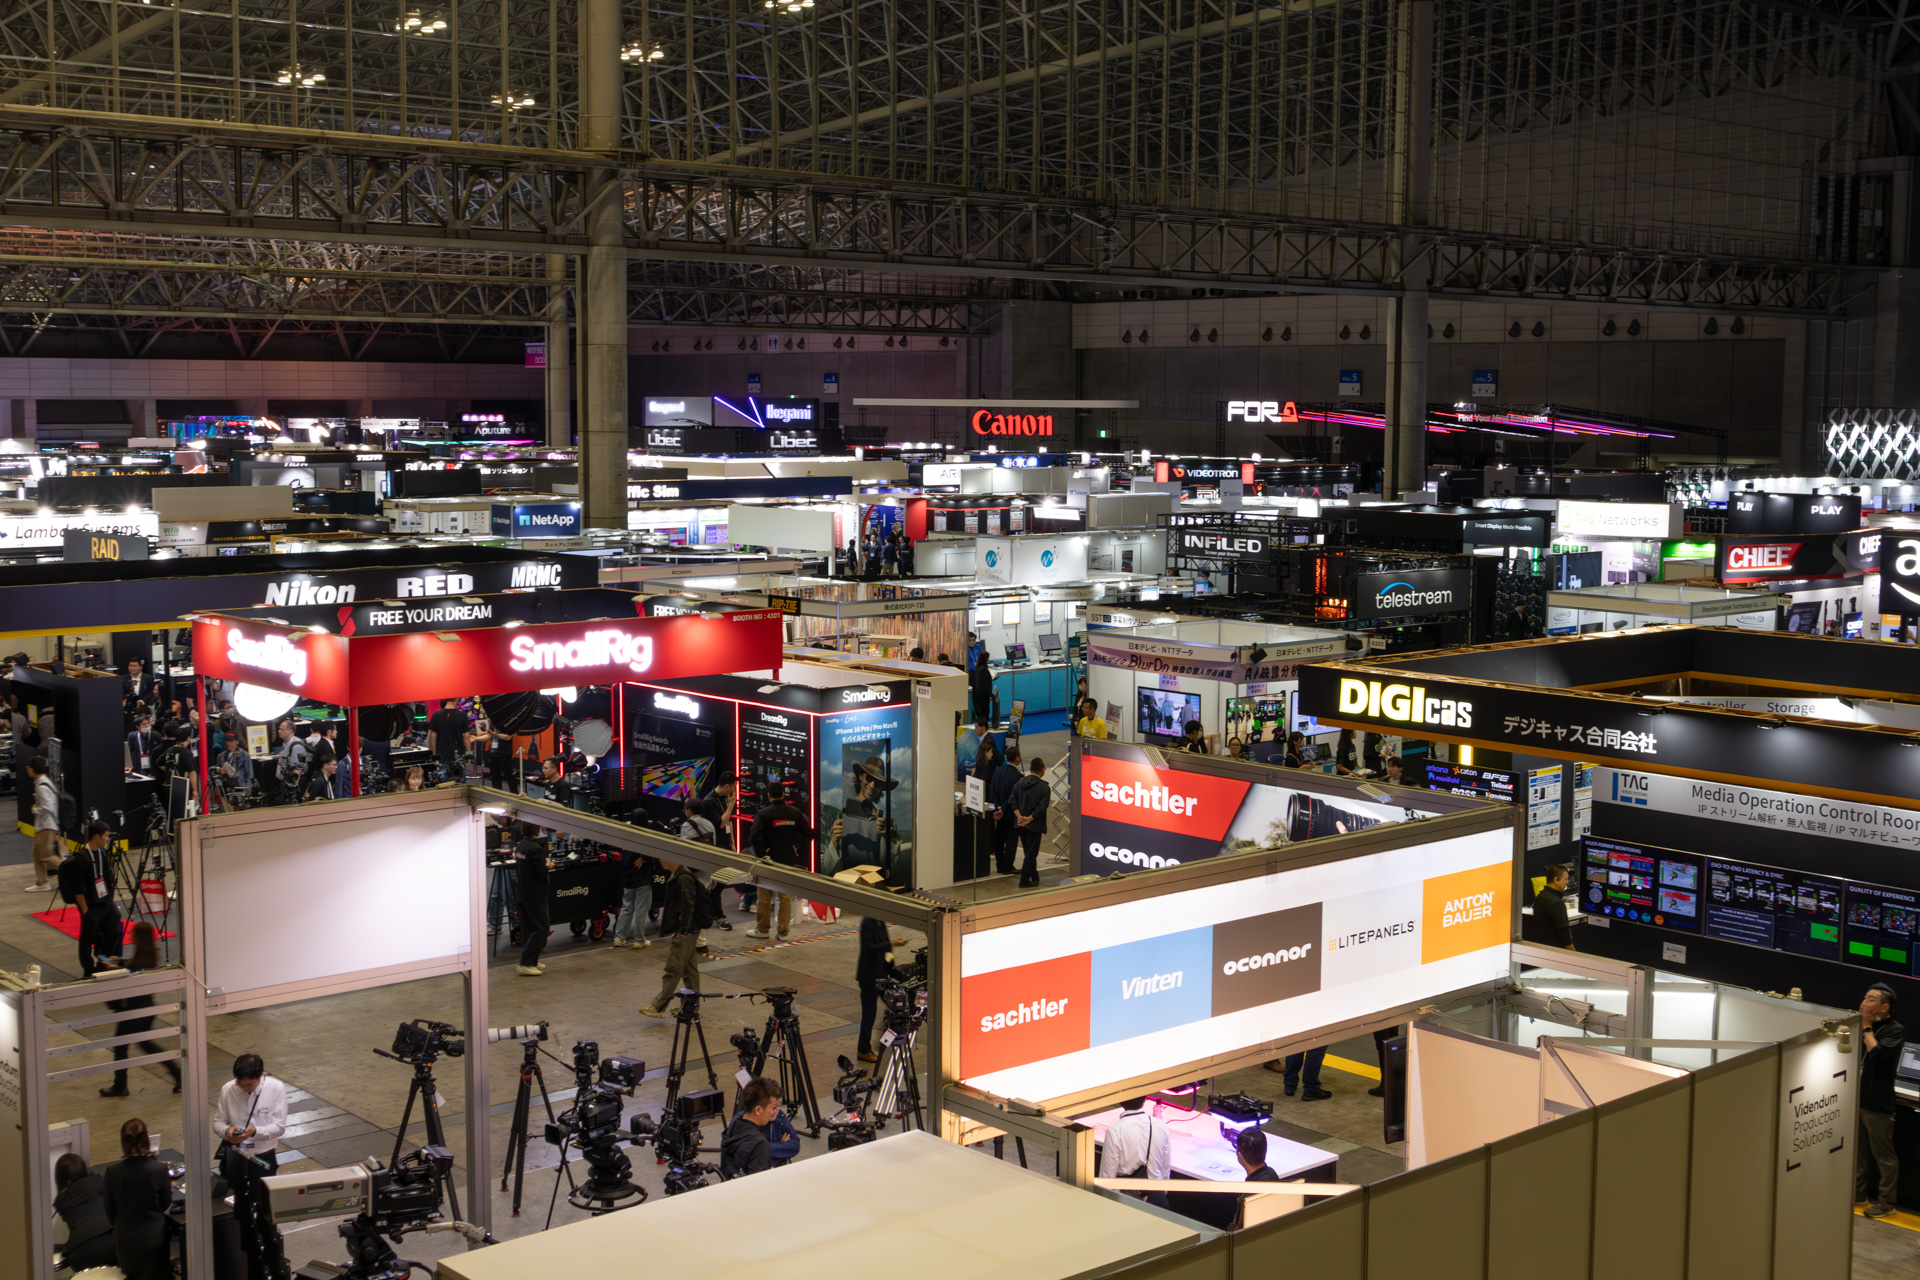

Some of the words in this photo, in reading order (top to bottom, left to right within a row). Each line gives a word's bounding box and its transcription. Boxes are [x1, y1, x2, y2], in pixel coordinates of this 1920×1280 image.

[766, 404, 812, 423] Ikegami
[972, 409, 1053, 436] Canon
[474, 425, 512, 437] Aputure
[647, 434, 681, 447] Libec
[770, 435, 818, 448] Libec
[1186, 469, 1238, 478] VIDEOTRON
[652, 485, 680, 498] Sim
[1736, 502, 1754, 512] PLAY
[1811, 505, 1844, 515] PLAY
[532, 514, 574, 526] NetApp
[1575, 512, 1596, 524] TVU
[1600, 514, 1659, 526] Networks
[91, 536, 120, 560] RAID
[1859, 535, 1882, 556] CHIEF
[1728, 546, 1793, 568] CHIEF
[396, 574, 474, 598] RED
[511, 564, 562, 588] MRMC
[264, 580, 356, 606] Nikon
[1376, 589, 1452, 610] telestream
[772, 598, 798, 610] RIP-TIE
[884, 602, 926, 611] 株式会社RIP-TIE
[370, 610, 404, 626] FREE
[405, 607, 444, 624] YOUR
[446, 604, 492, 621] DREAM
[733, 614, 753, 622] BOOTH
[509, 628, 653, 672] SmallRig
[1128, 643, 1194, 656] 日本テレビ・NTTデータ
[1276, 644, 1334, 658] 日本テレビ・NTTデータ
[918, 688, 930, 696] 4301
[1767, 702, 1816, 717] Storage
[835, 728, 854, 736] iPhone
[842, 731, 891, 742] モバイルビデオキット
[1503, 716, 1658, 754] デジキャス合同会社
[1426, 764, 1449, 774] arkona
[1460, 768, 1478, 776] caton
[1482, 772, 1510, 782] BFE
[1621, 774, 1648, 791] TAG
[1090, 780, 1198, 816] sachtler
[1692, 784, 1735, 804] Media
[1739, 791, 1814, 816] Operation
[1818, 803, 1878, 826] Control
[1698, 804, 1708, 814] IP
[1710, 806, 1827, 834] ストリーム解析・無人監視
[1836, 825, 1846, 834] IP
[1742, 867, 1764, 876] LATENCY
[1770, 872, 1784, 880] SYNC
[556, 886, 589, 899] SmallRig
[1443, 892, 1494, 915] ANTON
[1443, 905, 1493, 928] BAUER
[1338, 920, 1415, 950] LITEPANELS
[1224, 942, 1312, 976] oconnor
[1122, 970, 1183, 1001] Vinten
[980, 997, 1068, 1033] sachtler
[1794, 1093, 1838, 1118] Videndum
[1794, 1108, 1840, 1136] Production
[1793, 1127, 1834, 1152] Solutions
